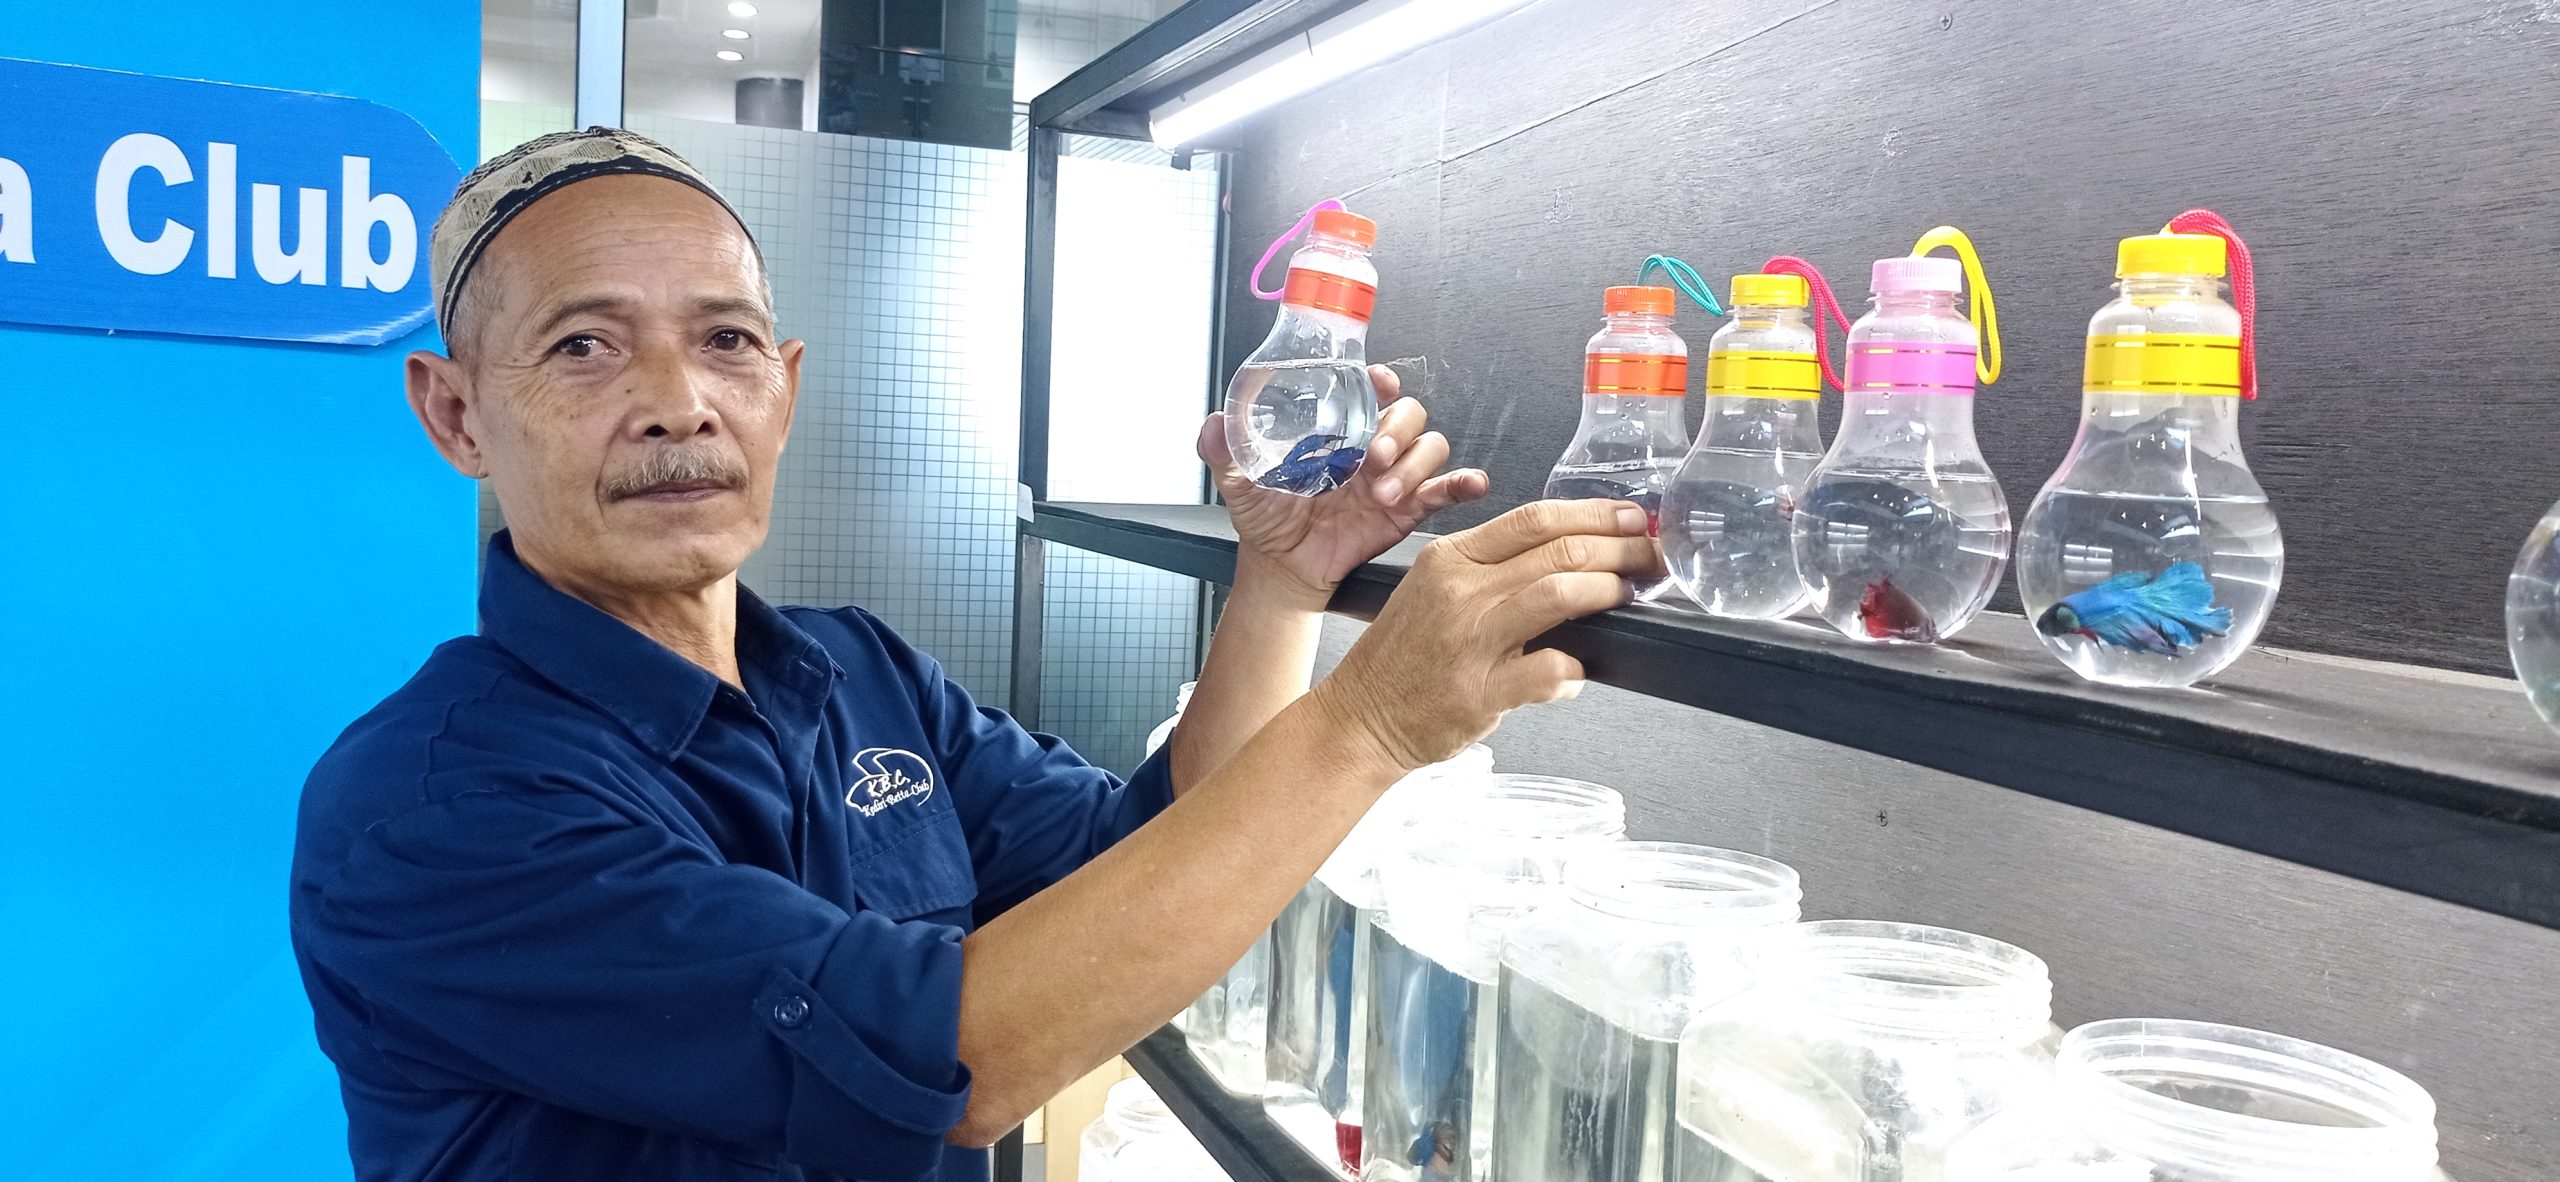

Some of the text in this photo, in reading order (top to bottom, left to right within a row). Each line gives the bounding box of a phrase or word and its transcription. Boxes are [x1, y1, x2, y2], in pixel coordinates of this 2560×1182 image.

[95, 132, 418, 293] Club
[886, 789, 910, 806] Betta
[911, 778, 930, 796] Club
